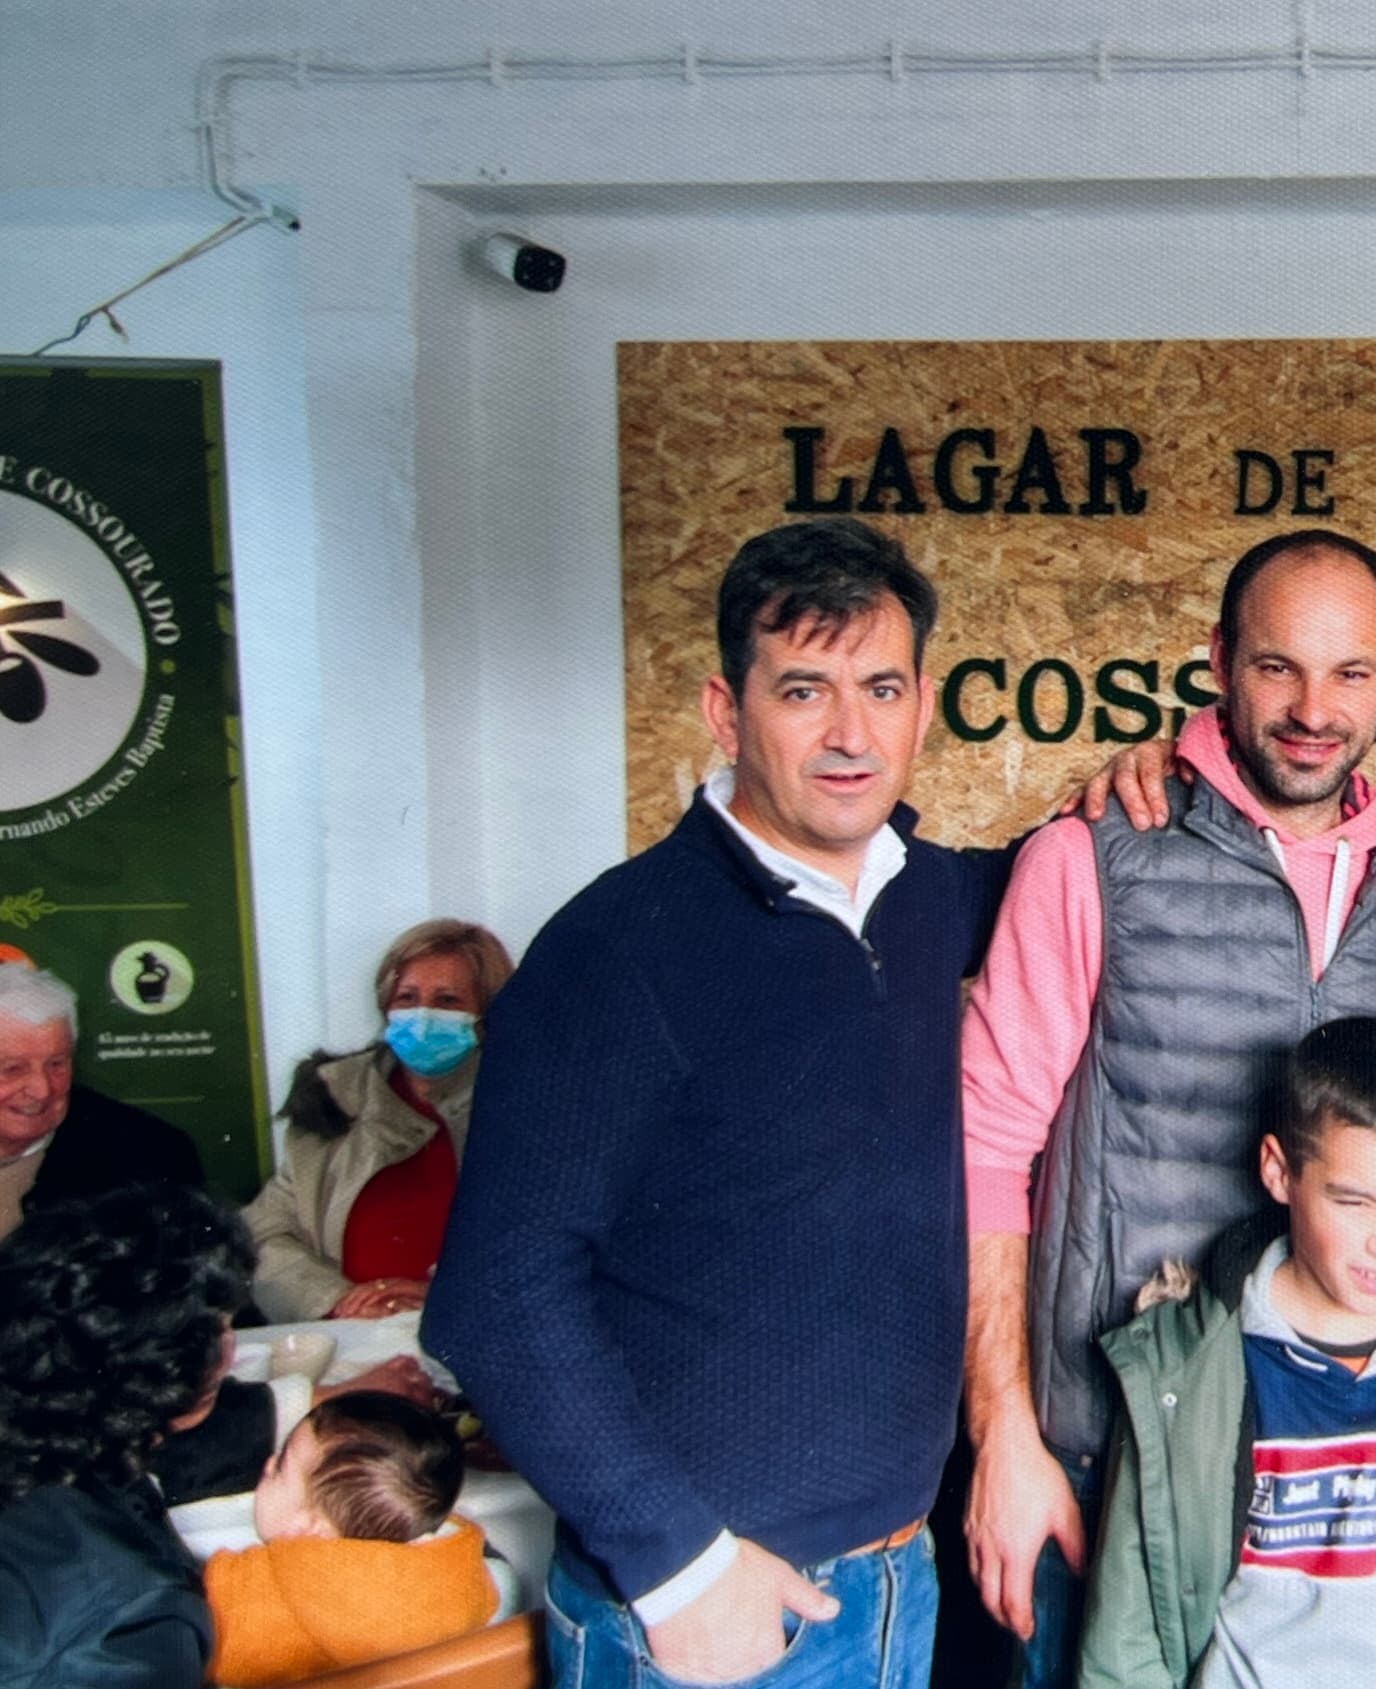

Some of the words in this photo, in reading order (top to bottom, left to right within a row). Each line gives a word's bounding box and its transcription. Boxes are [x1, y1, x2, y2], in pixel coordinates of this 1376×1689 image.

[783, 426, 1149, 516] LAGAR
[1232, 449, 1336, 518] DE
[0, 454, 17, 484] E
[26, 467, 181, 645] COSSOURADO
[0, 809, 70, 840] rnando
[67, 768, 138, 819] Esteves
[124, 693, 176, 769] Baptista
